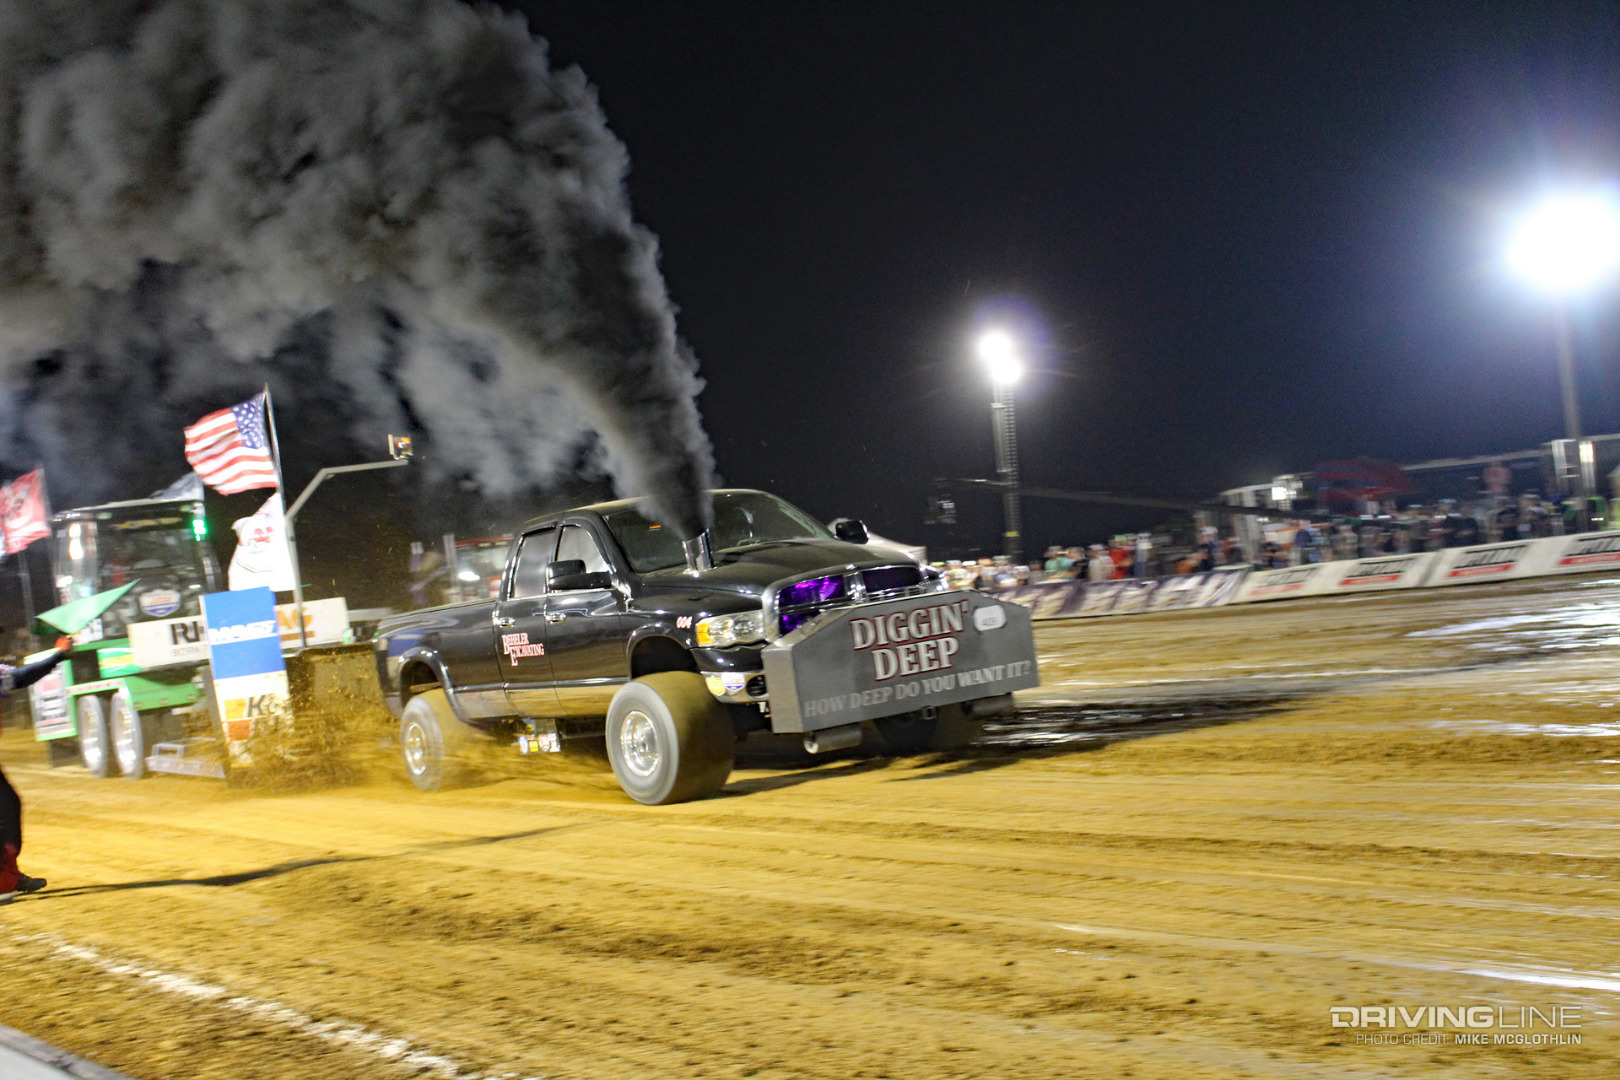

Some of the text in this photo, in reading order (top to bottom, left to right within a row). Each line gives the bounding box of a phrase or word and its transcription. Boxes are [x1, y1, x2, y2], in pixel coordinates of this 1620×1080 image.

[849, 599, 969, 650] DIGGIN'
[871, 636, 959, 681] DEEP
[804, 660, 1031, 718] HOW DEEP DO YOU WANT IT?
